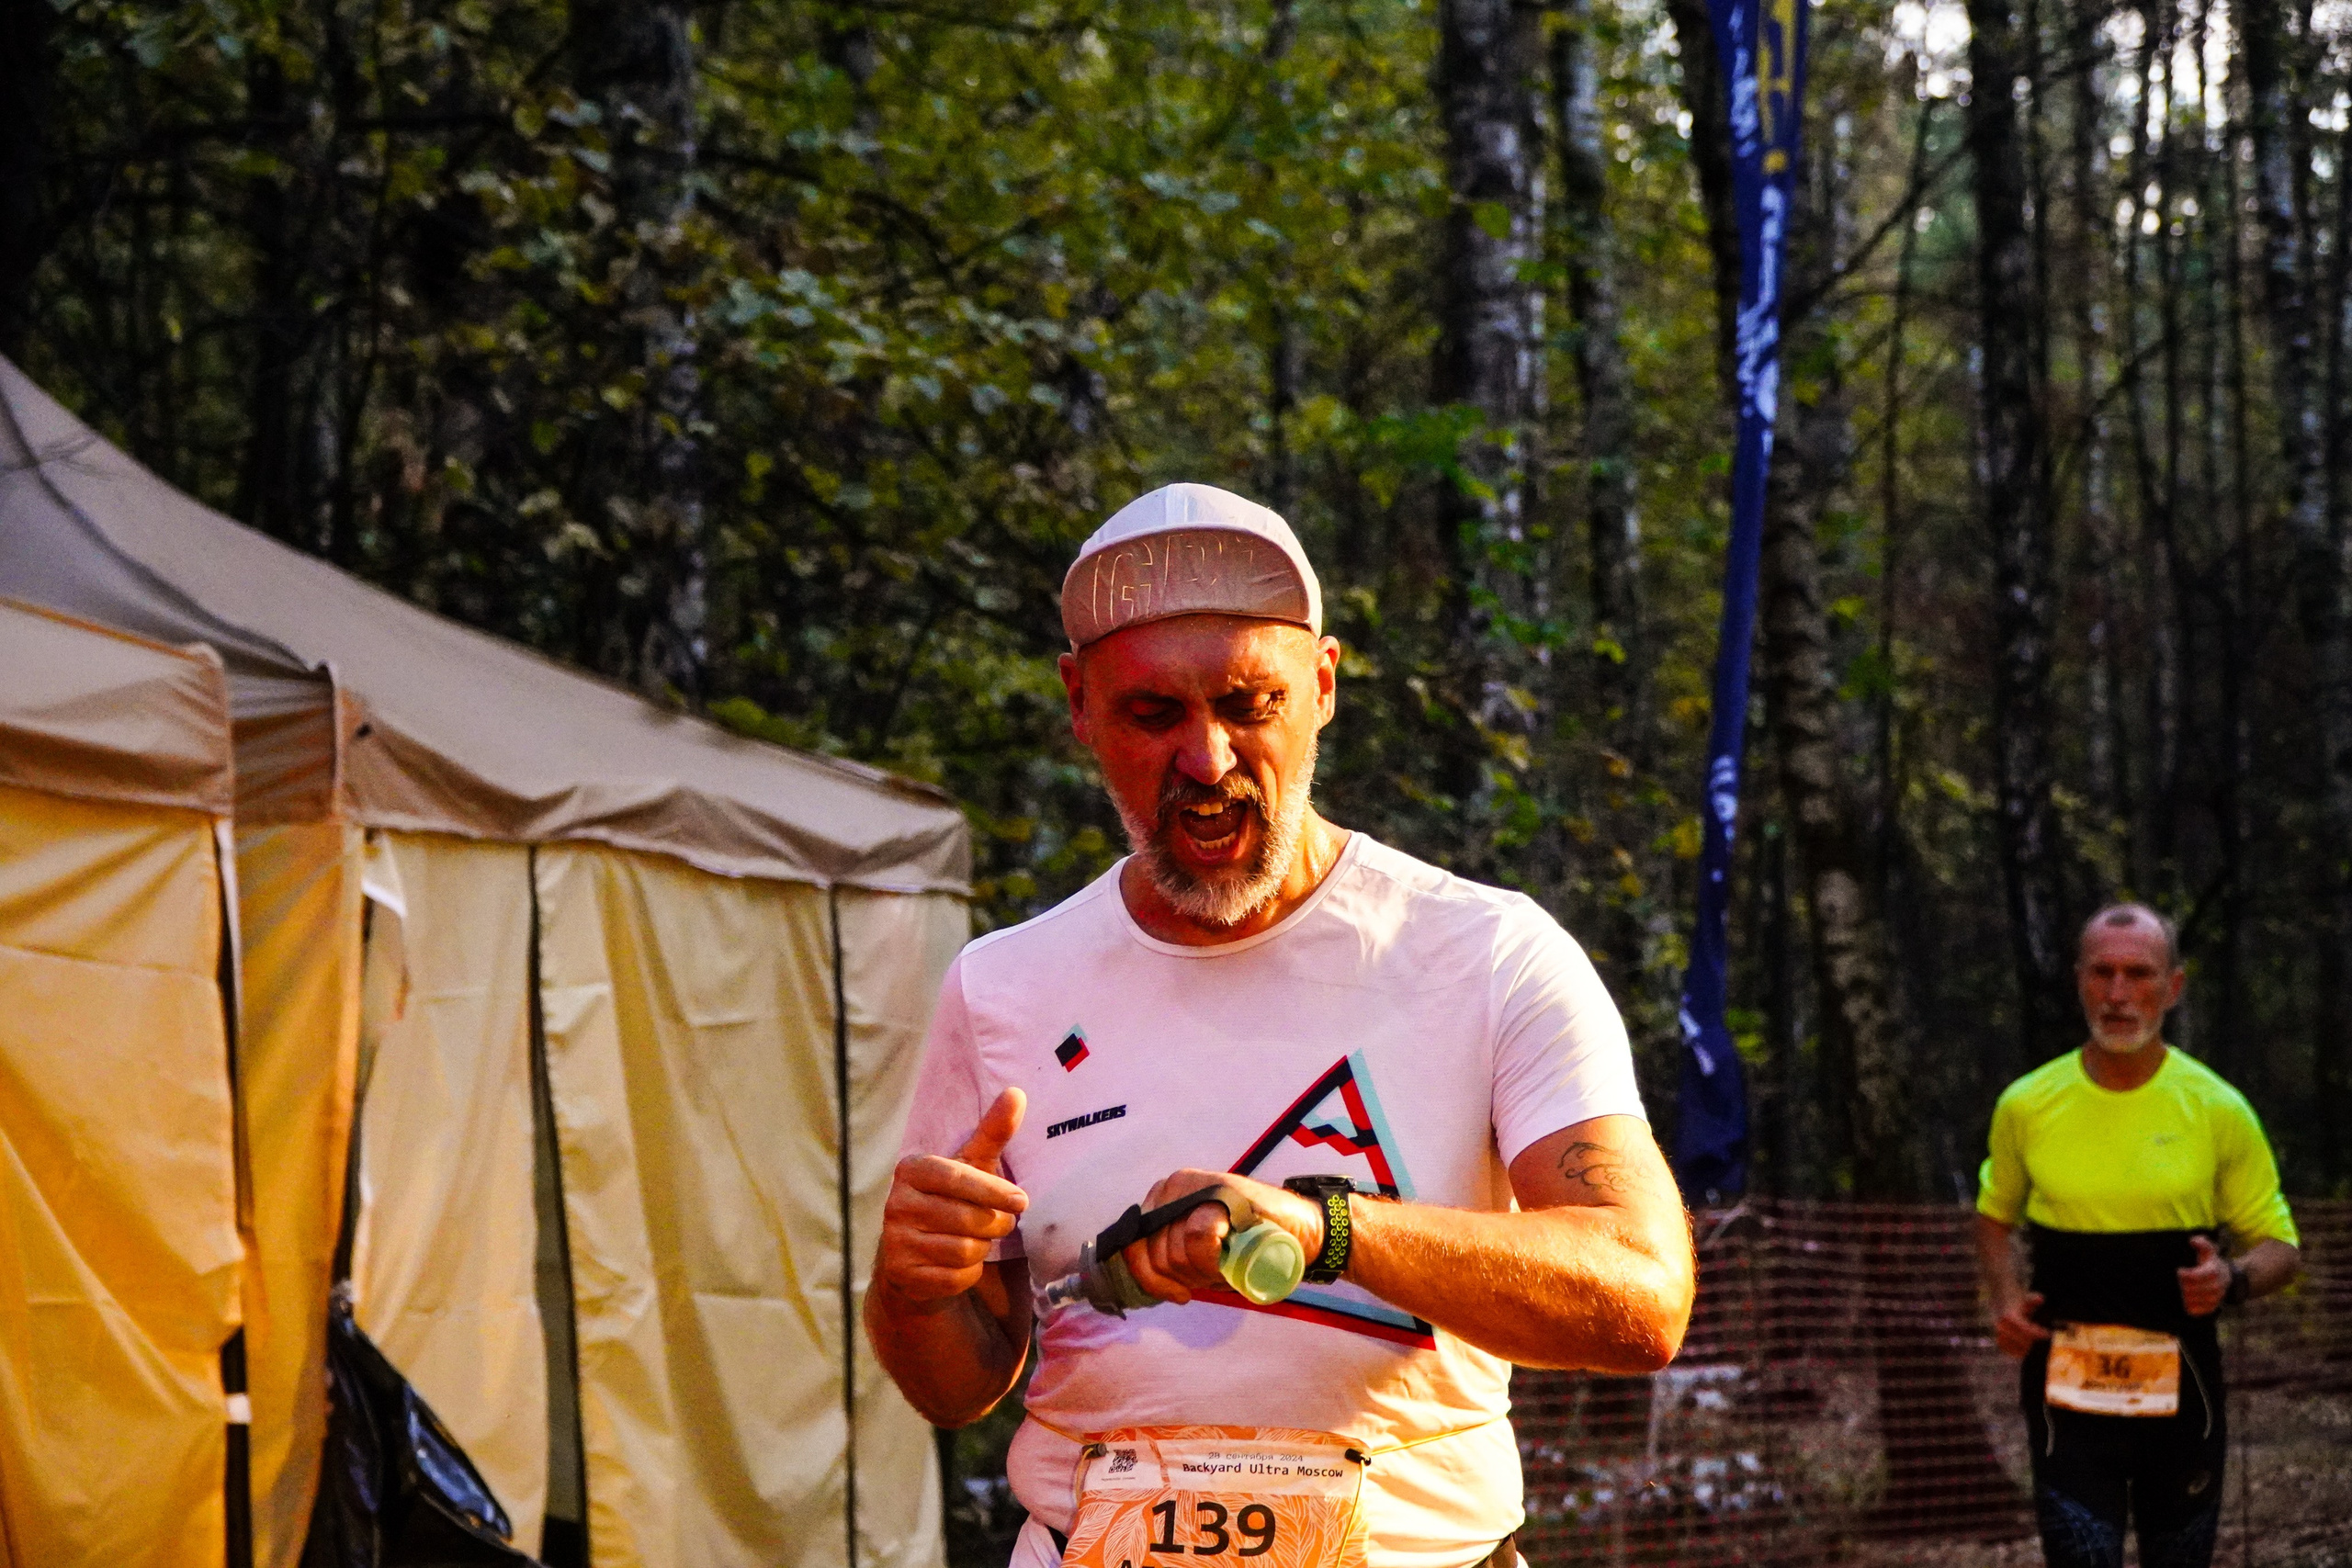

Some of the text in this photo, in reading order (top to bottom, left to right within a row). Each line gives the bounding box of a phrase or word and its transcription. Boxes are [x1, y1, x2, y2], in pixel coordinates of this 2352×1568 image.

[1046, 1104, 1126, 1139] SKYWALKERS
[1226, 1452, 1274, 1461] сентября
[1279, 1453, 1304, 1462] 2024
[1182, 1462, 1343, 1478] Backyard Ultra Moscow
[1148, 1499, 1276, 1557] 139
